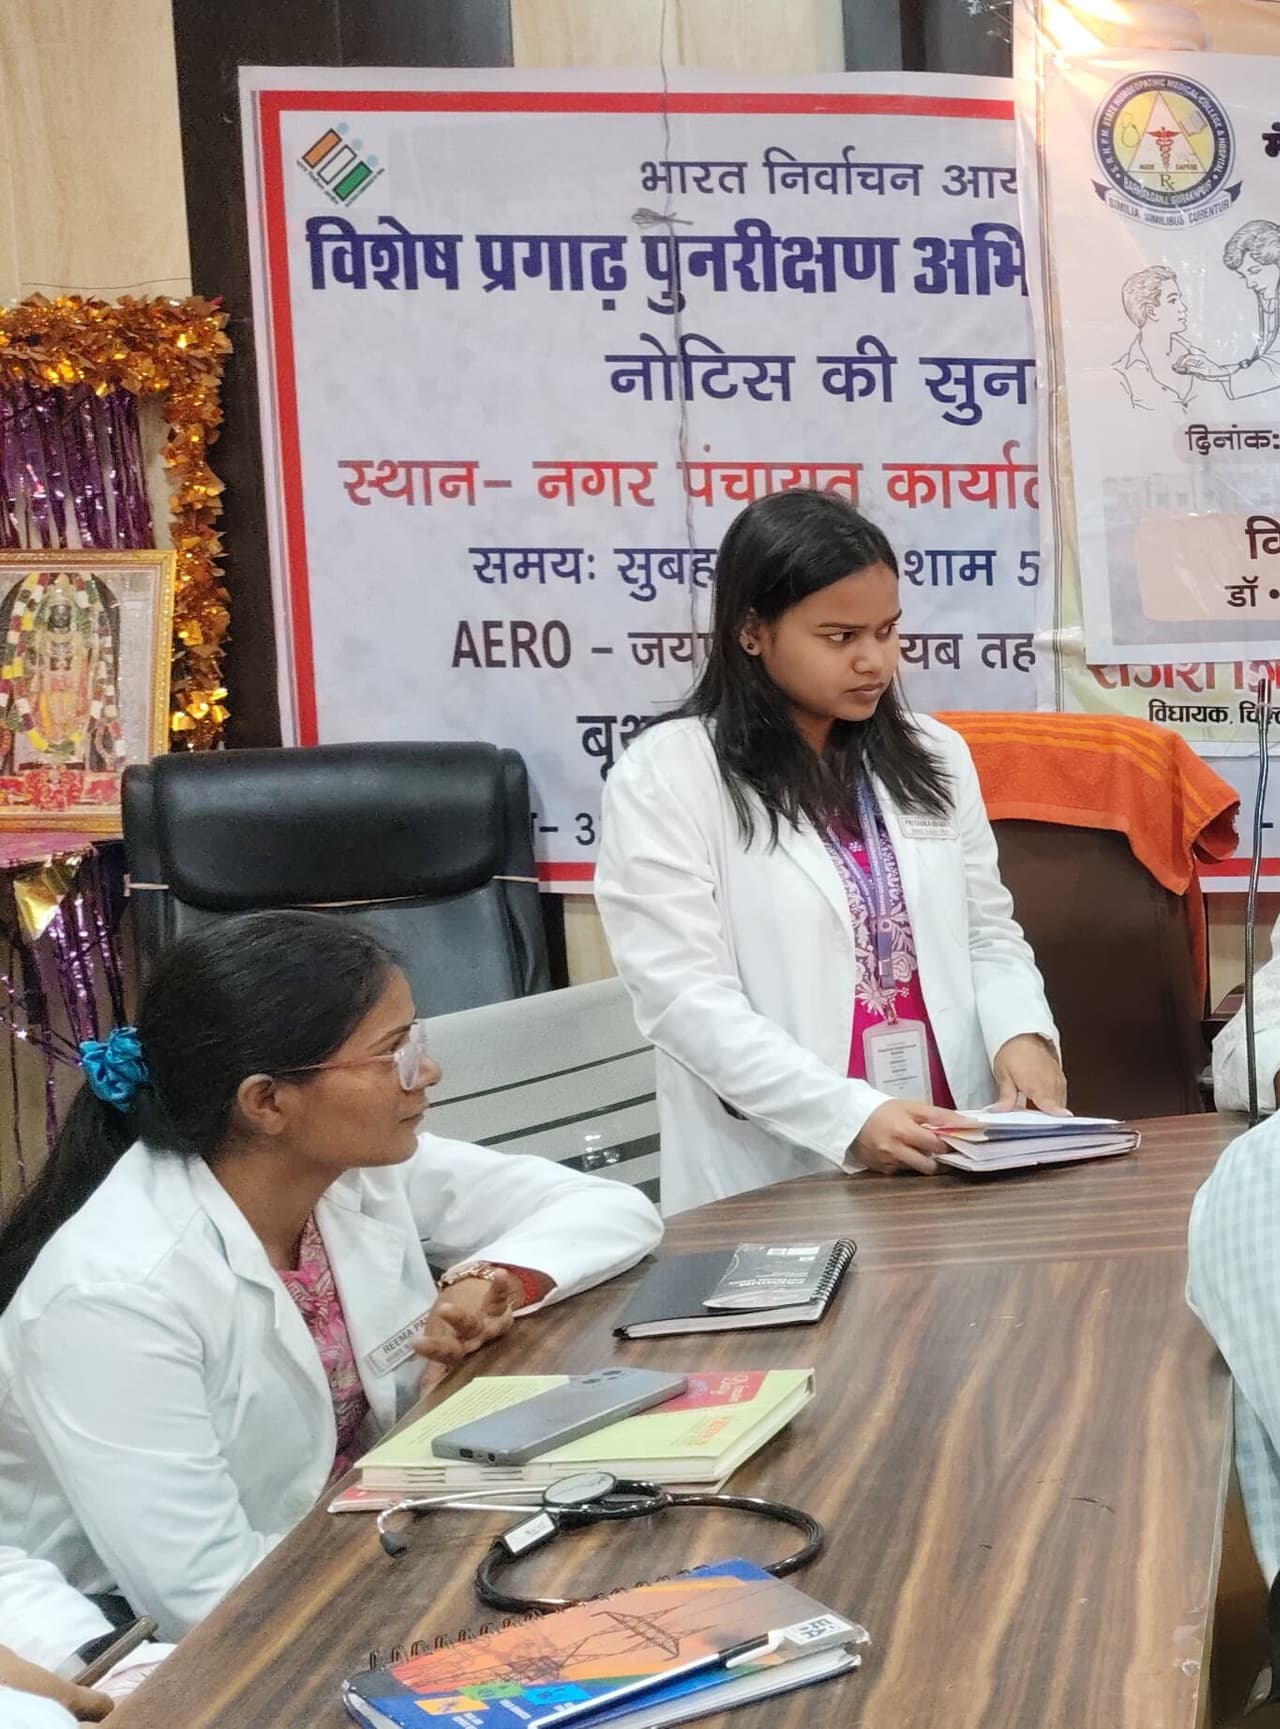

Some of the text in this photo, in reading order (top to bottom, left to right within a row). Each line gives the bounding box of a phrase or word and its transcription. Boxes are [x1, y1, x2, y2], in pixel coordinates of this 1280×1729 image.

[1167, 78, 1199, 100] MEDICAL
[1198, 95, 1222, 128] COLLEGE
[1216, 136, 1229, 175] HOSPITAL
[641, 145, 1019, 198] भारत निर्वाचन आय
[1188, 198, 1231, 223] CURENTUR
[306, 216, 1028, 315] विशेष प्रगाढ़ पुनरीक्षण अभि
[605, 333, 1036, 427] नोटिस की सुन
[532, 460, 658, 508] नगर
[676, 443, 864, 509] पंचायत
[881, 440, 1039, 510] कार्या
[613, 548, 719, 602] सुबह
[903, 550, 997, 586] शाम
[1225, 576, 1258, 608] डॉ
[451, 619, 572, 669] AERO
